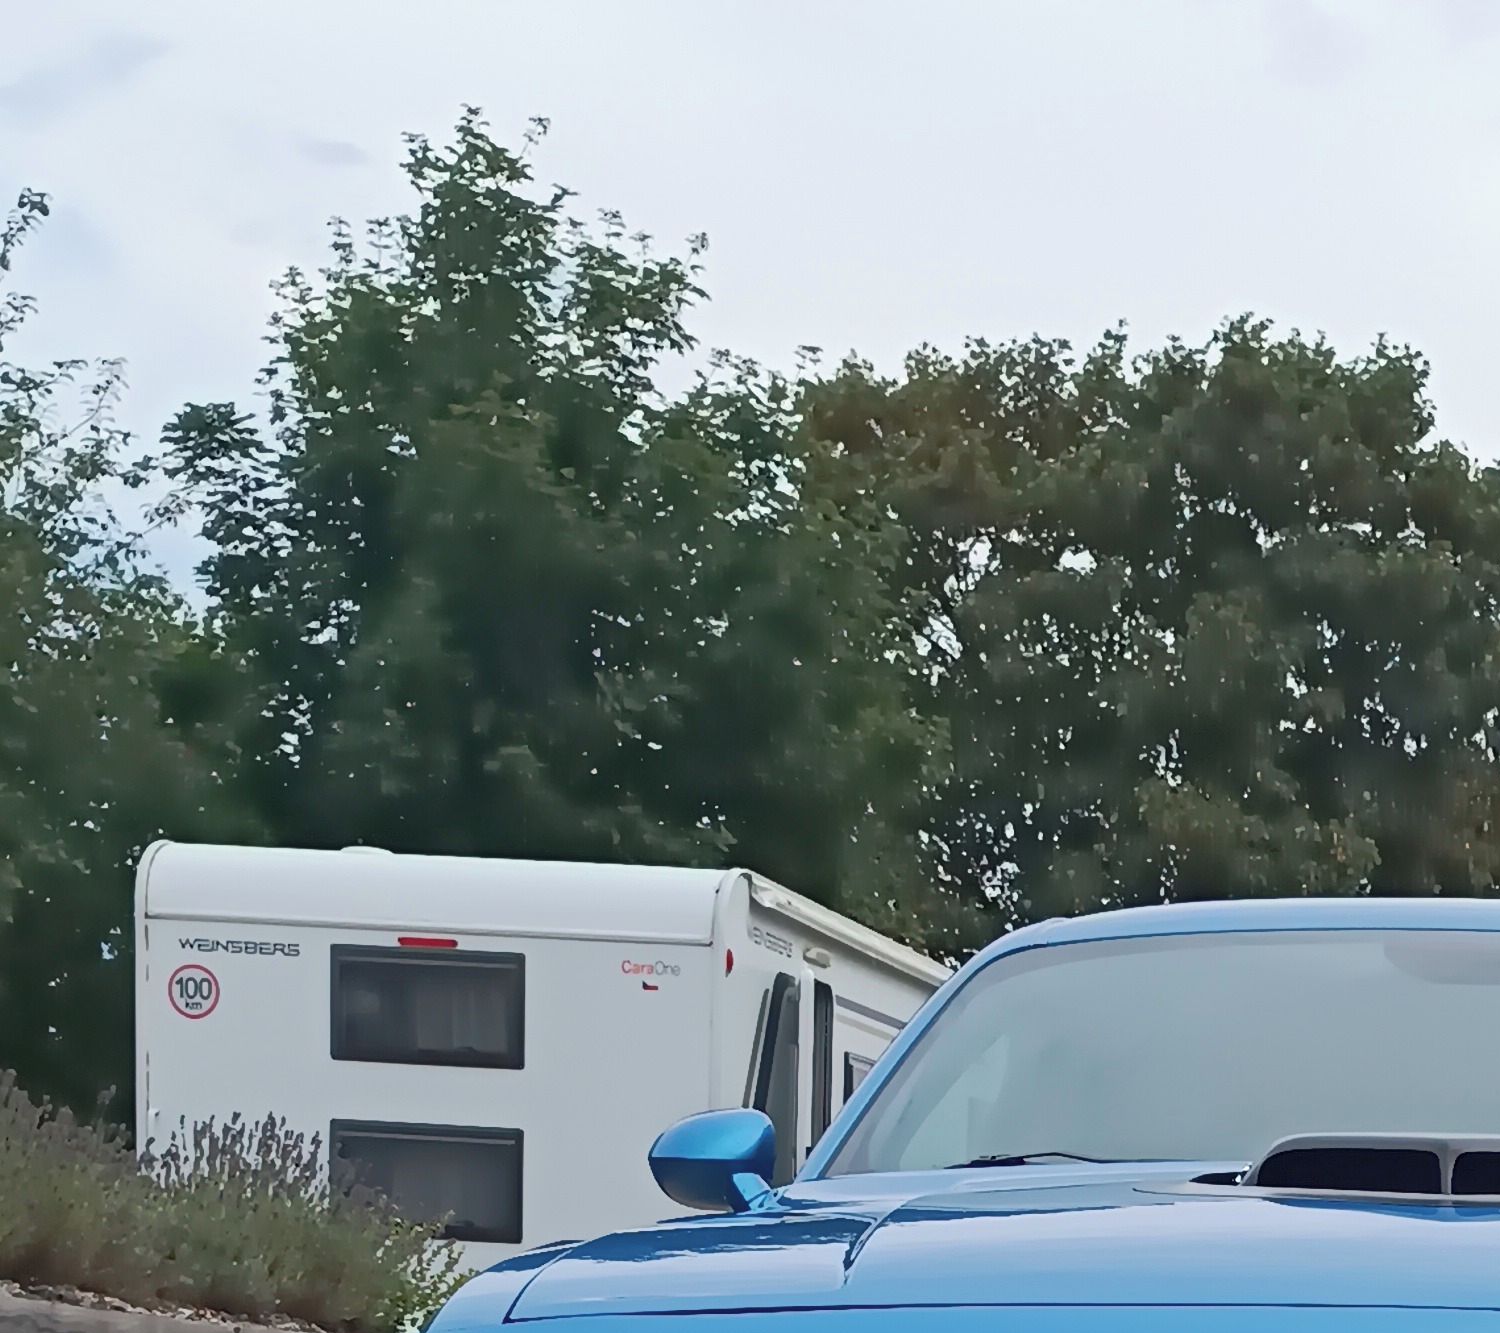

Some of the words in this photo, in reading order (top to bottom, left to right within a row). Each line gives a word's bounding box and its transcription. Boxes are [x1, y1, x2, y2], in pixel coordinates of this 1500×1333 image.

[621, 960, 681, 976] CaraOne
[175, 976, 213, 1000] 100
[185, 999, 203, 1010] km
